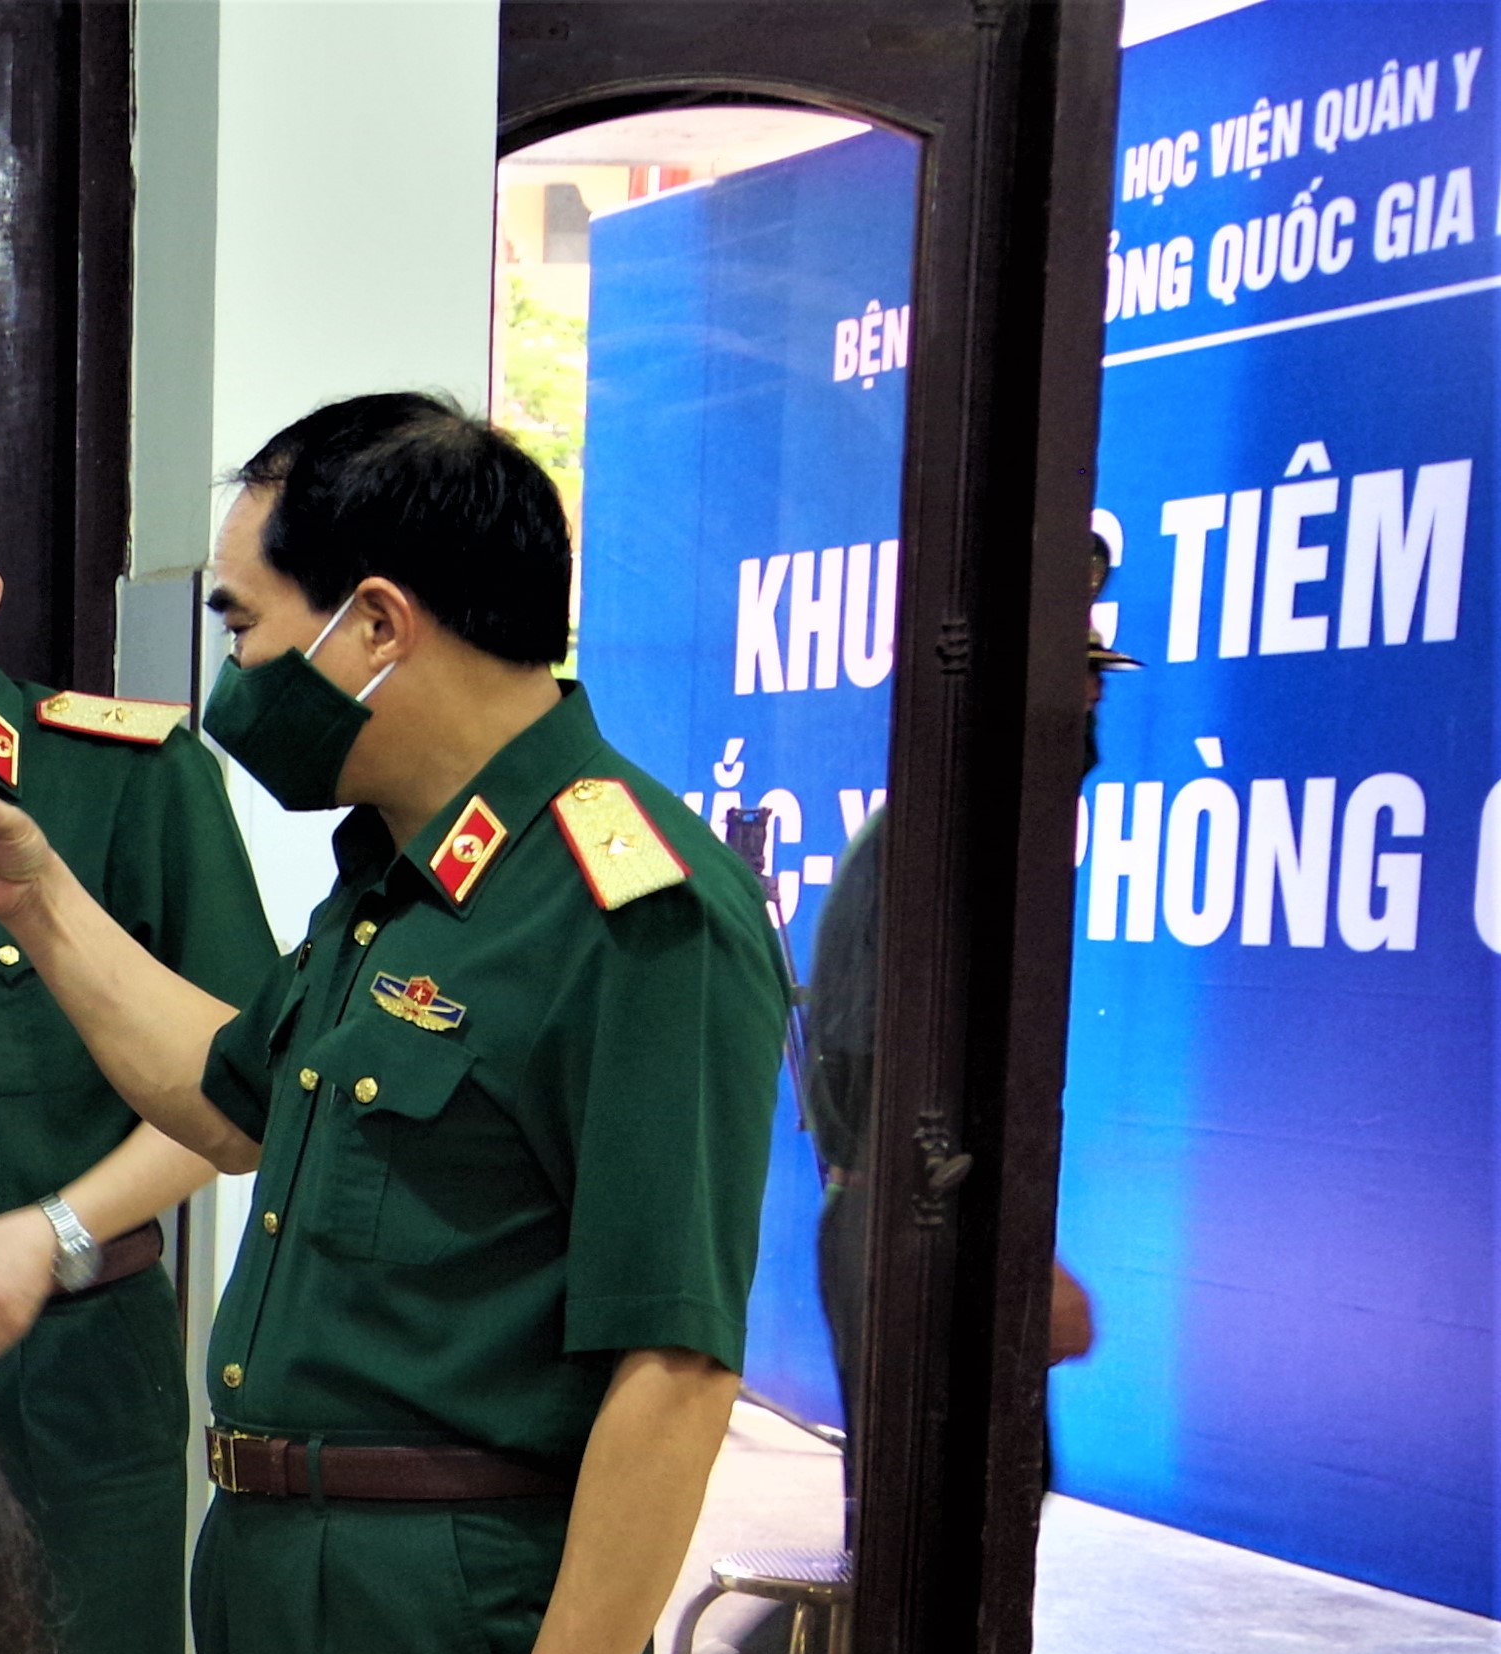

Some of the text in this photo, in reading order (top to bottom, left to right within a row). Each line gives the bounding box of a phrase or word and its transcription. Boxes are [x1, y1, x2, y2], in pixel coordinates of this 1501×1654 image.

[1122, 46, 1484, 206] HỌC VIỆN QUÂN Y
[833, 298, 910, 390] BỆN
[1103, 230, 1195, 324] ỎNG
[1207, 176, 1357, 306] QUỐC
[1372, 167, 1475, 264] GIA
[734, 538, 900, 696] KHU
[1160, 441, 1472, 664] TIÊM
[1074, 736, 1427, 953] HÒNG
